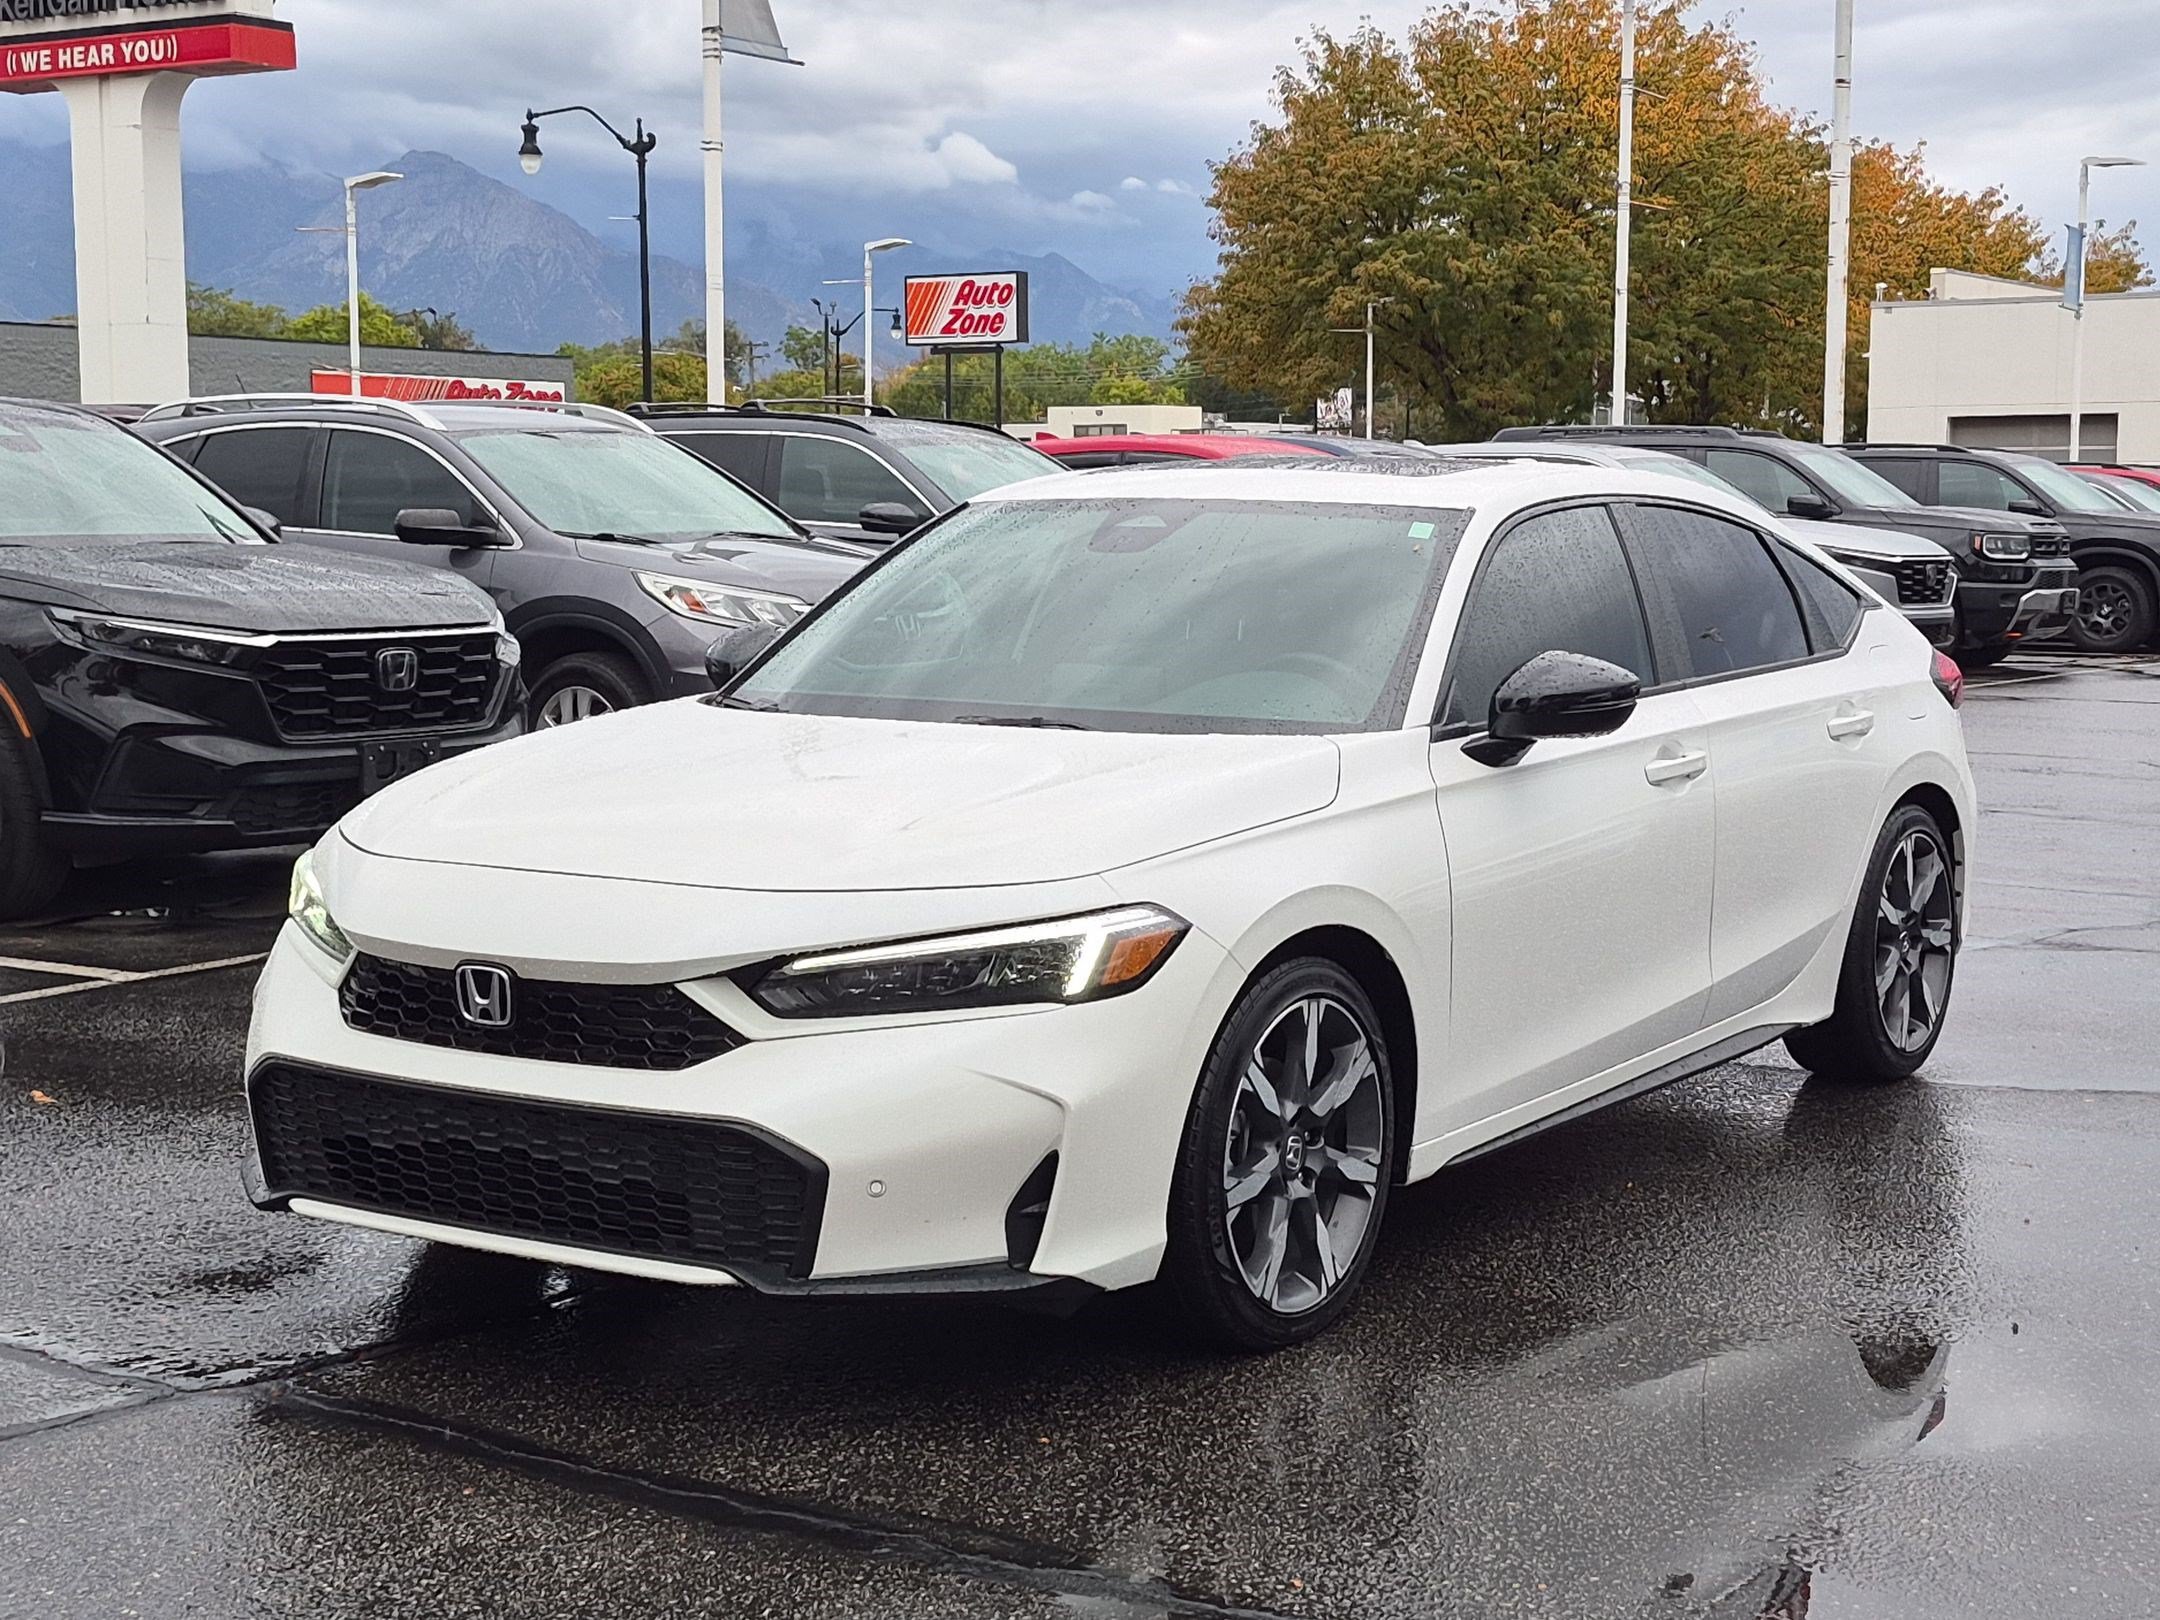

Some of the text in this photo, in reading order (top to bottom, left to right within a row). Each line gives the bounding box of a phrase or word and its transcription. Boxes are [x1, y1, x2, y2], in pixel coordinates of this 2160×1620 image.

[58, 44, 115, 69] HEAR
[952, 279, 1014, 306] Auto
[939, 308, 1005, 335] Zone
